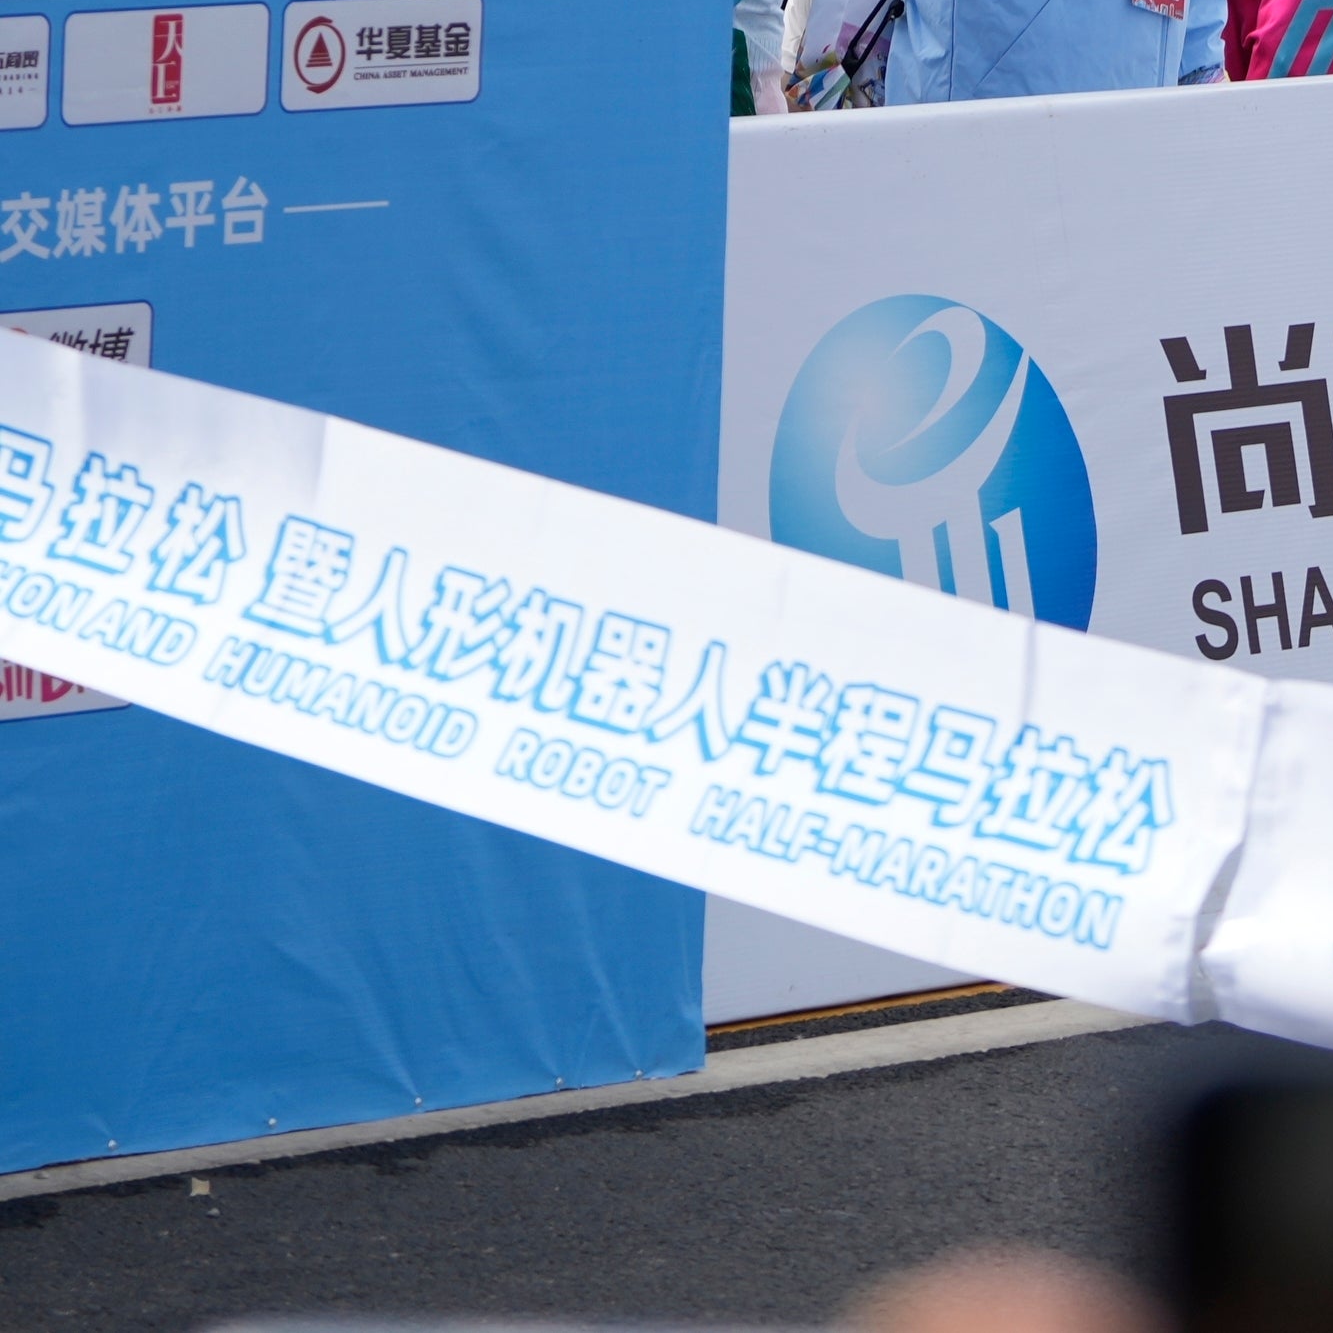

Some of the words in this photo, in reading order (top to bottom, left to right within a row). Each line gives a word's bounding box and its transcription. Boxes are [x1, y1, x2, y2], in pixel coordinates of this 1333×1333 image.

[353, 70, 381, 81] CHINA
[382, 69, 408, 79] ASSET
[409, 66, 469, 79] MANAGEMENT
[355, 21, 472, 61] 华夏基金
[77, 598, 199, 668] AND
[203, 635, 479, 759] HUMANOID
[495, 727, 673, 819] ROBOT
[689, 783, 1125, 951] HALF-MARATHON
[242, 514, 1176, 875] 暨人形机器人半程马拉松
